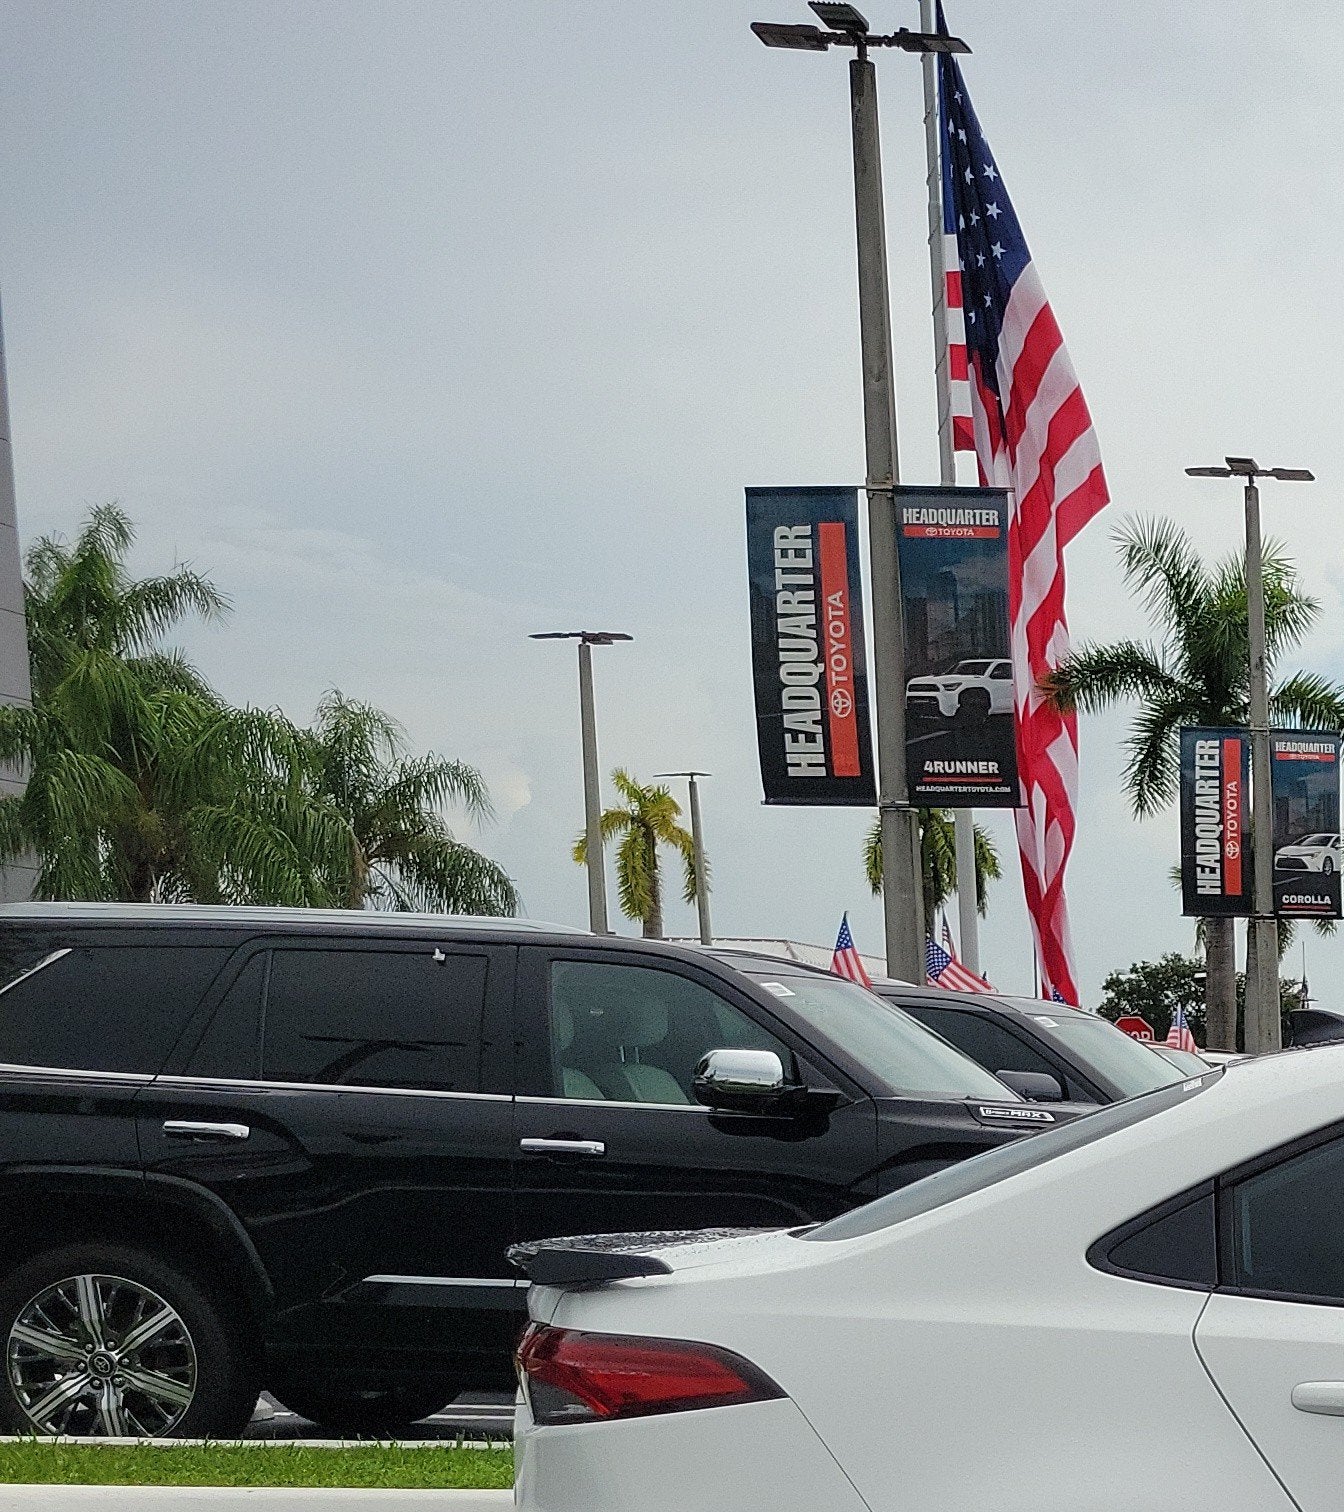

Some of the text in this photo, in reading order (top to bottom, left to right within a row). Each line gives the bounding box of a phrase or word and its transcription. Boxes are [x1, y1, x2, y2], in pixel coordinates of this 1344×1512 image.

[903, 508, 999, 526] HEADQUARTER
[938, 527, 975, 536] TOYOTA
[828, 590, 848, 686] TOYOTA
[774, 523, 826, 777] HEADQUARTER
[1275, 741, 1336, 754] HEADQUARTER
[924, 760, 999, 774] 4RUNNER
[1195, 739, 1223, 894] HEADQUARTER
[1226, 781, 1239, 838] TOYOTA
[1282, 895, 1332, 904] COROLLA
